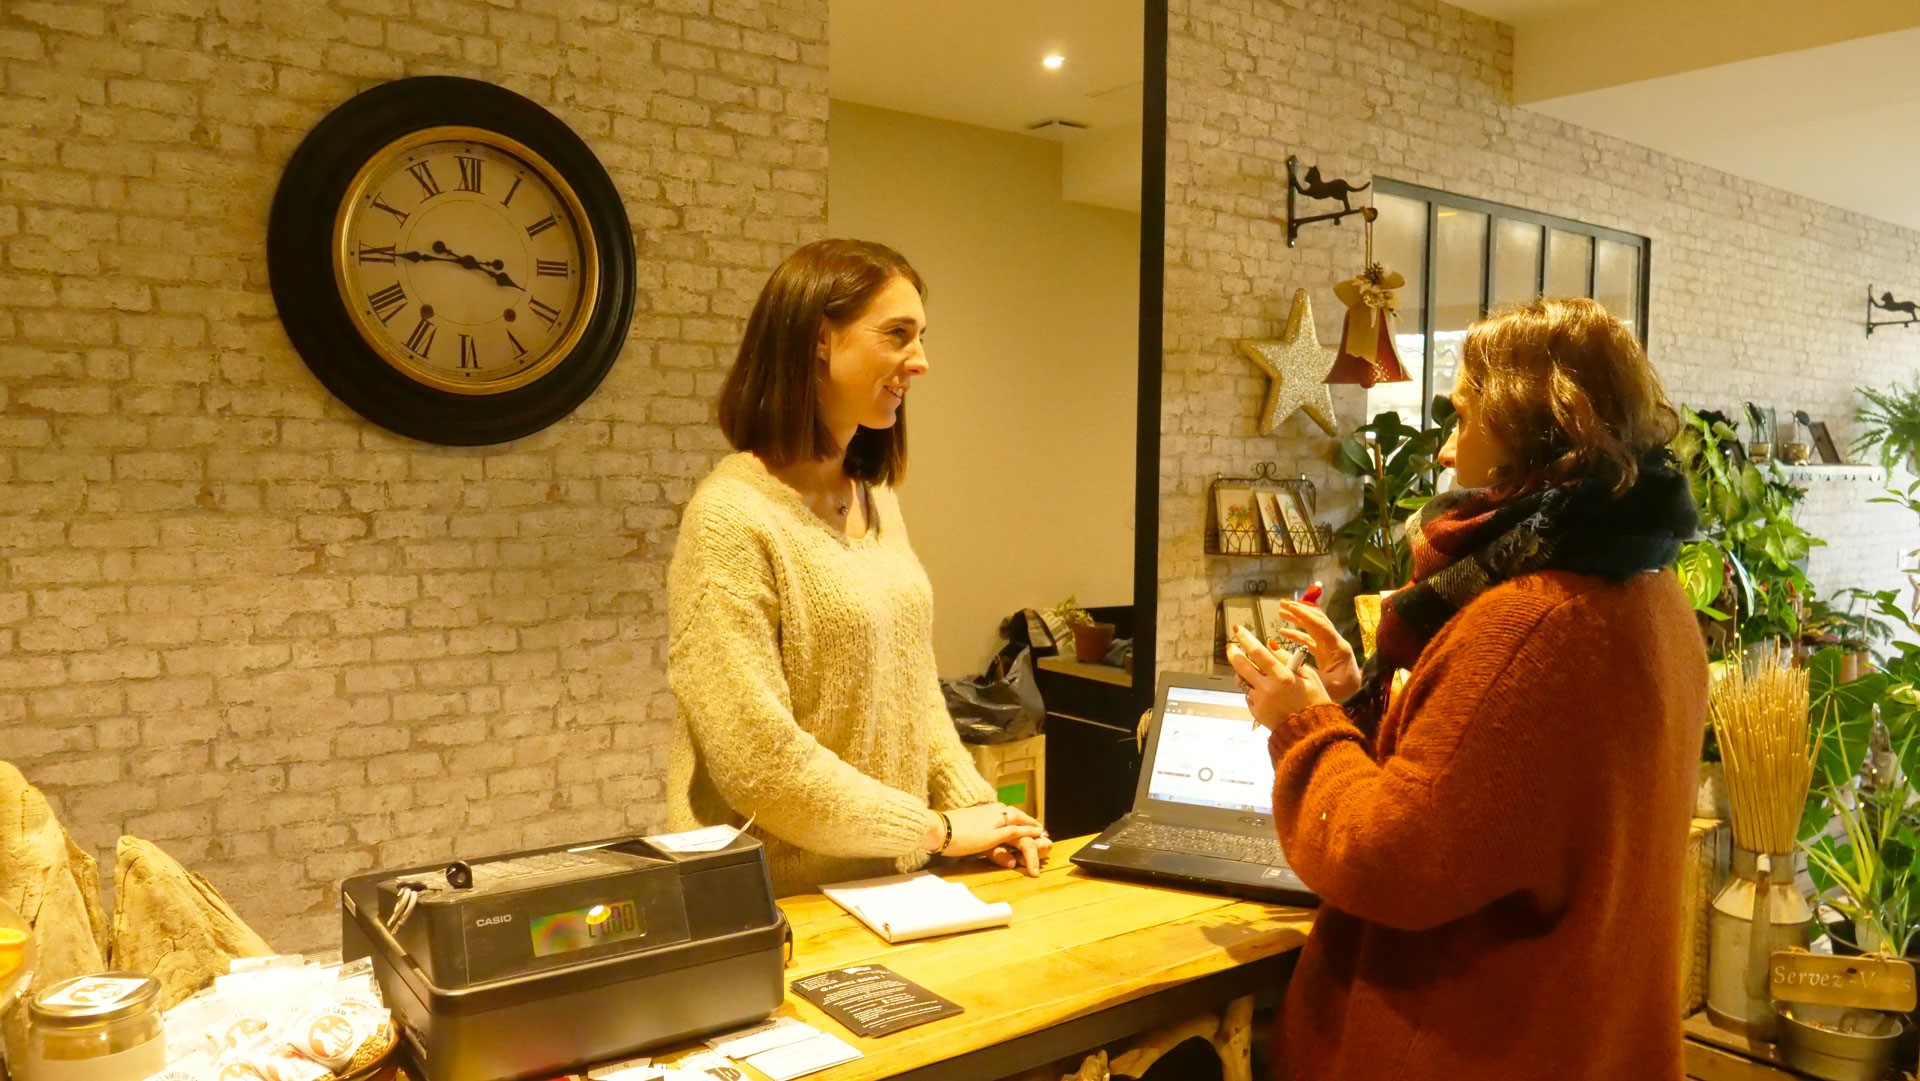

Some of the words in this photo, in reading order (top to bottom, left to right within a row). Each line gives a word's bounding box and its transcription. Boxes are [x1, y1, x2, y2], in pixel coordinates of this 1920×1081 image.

[405, 159, 446, 204] XI
[453, 155, 486, 195] XII
[500, 174, 523, 209] I
[370, 192, 411, 229] X
[524, 212, 559, 241] II
[358, 240, 397, 266] IX
[536, 257, 569, 280] III
[366, 280, 408, 327] VIII
[528, 296, 562, 333] IV
[402, 318, 438, 360] VII
[455, 333, 484, 370] VI
[505, 328, 529, 361] V
[475, 914, 513, 928] CASIO
[1773, 965, 1912, 991] Servez-Vs
